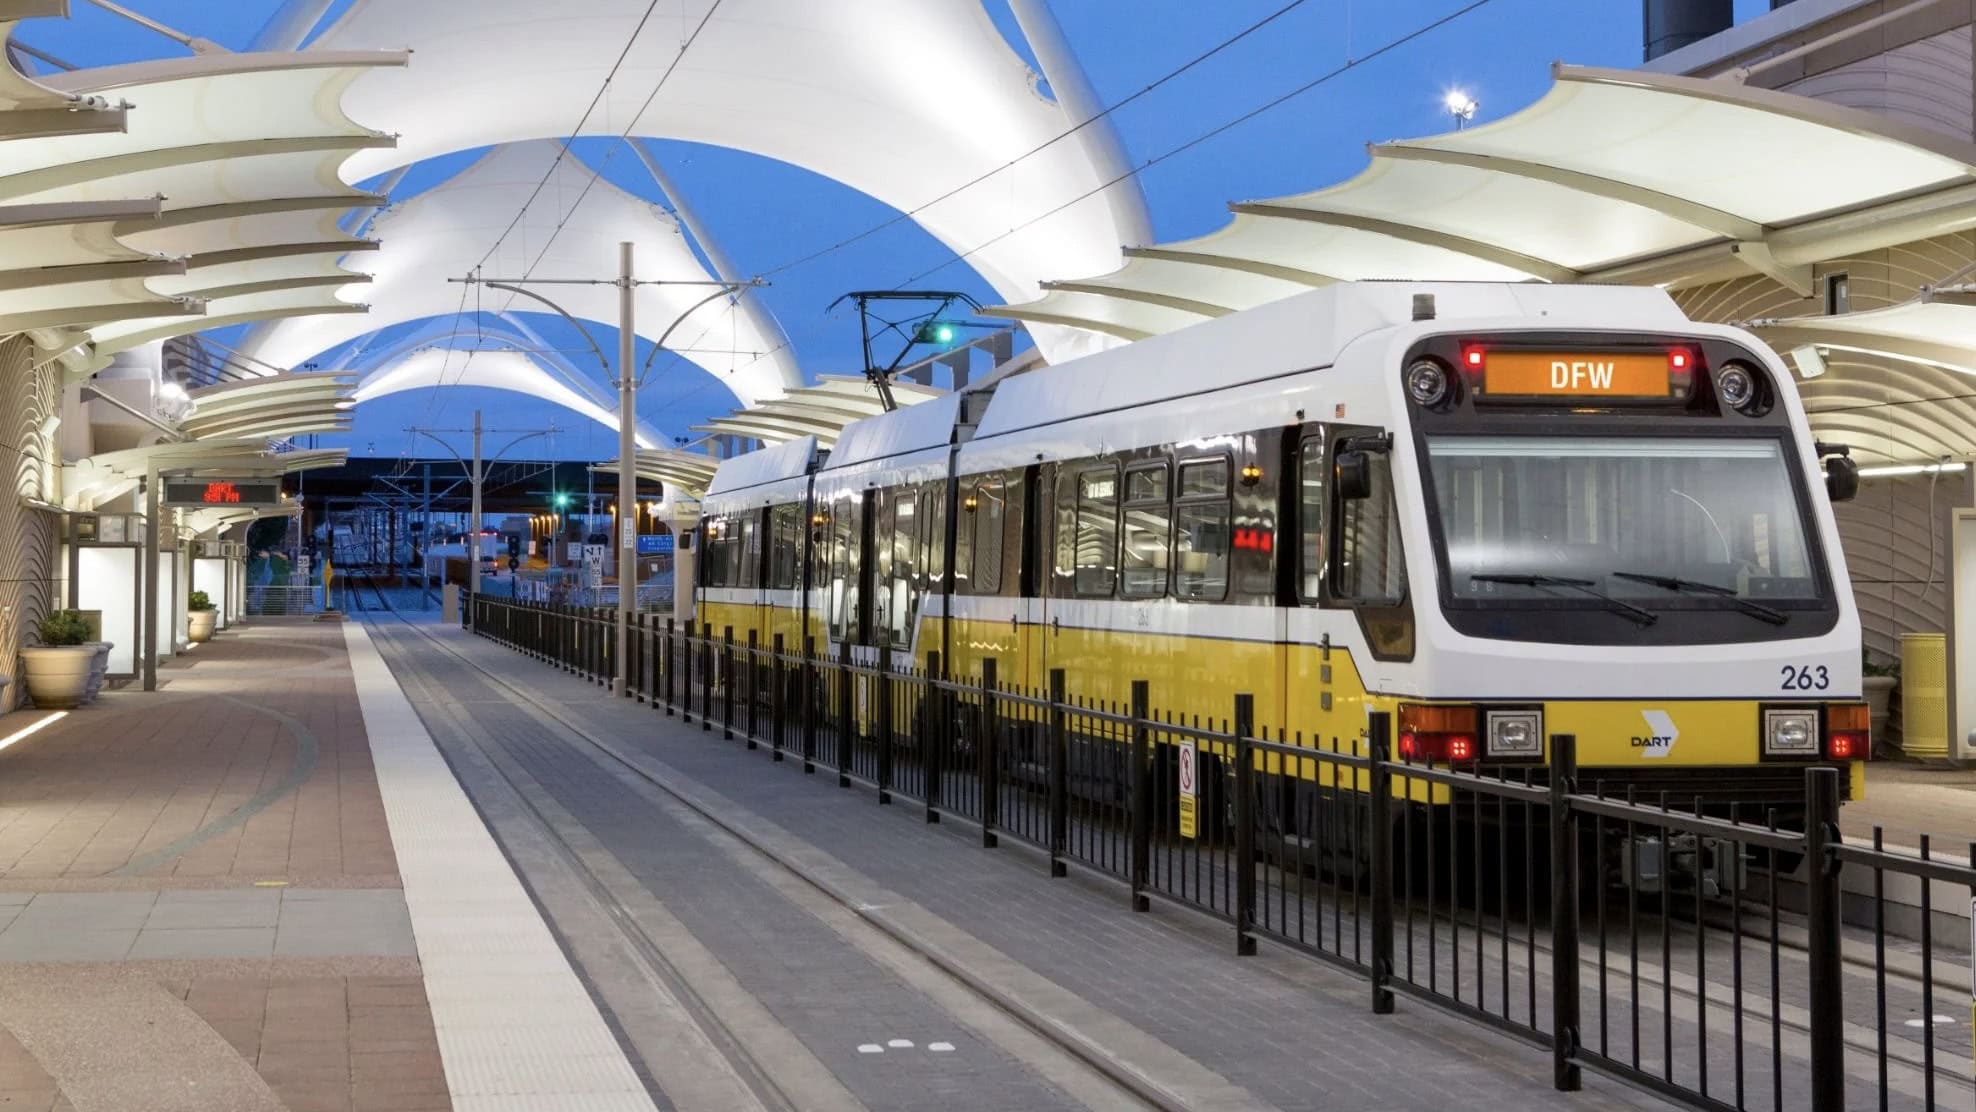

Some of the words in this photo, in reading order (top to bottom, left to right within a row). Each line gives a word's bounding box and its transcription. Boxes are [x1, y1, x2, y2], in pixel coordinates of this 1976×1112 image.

[1551, 361, 1614, 389] DFW
[1780, 665, 1830, 690] 263
[1631, 736, 1672, 747] DART
